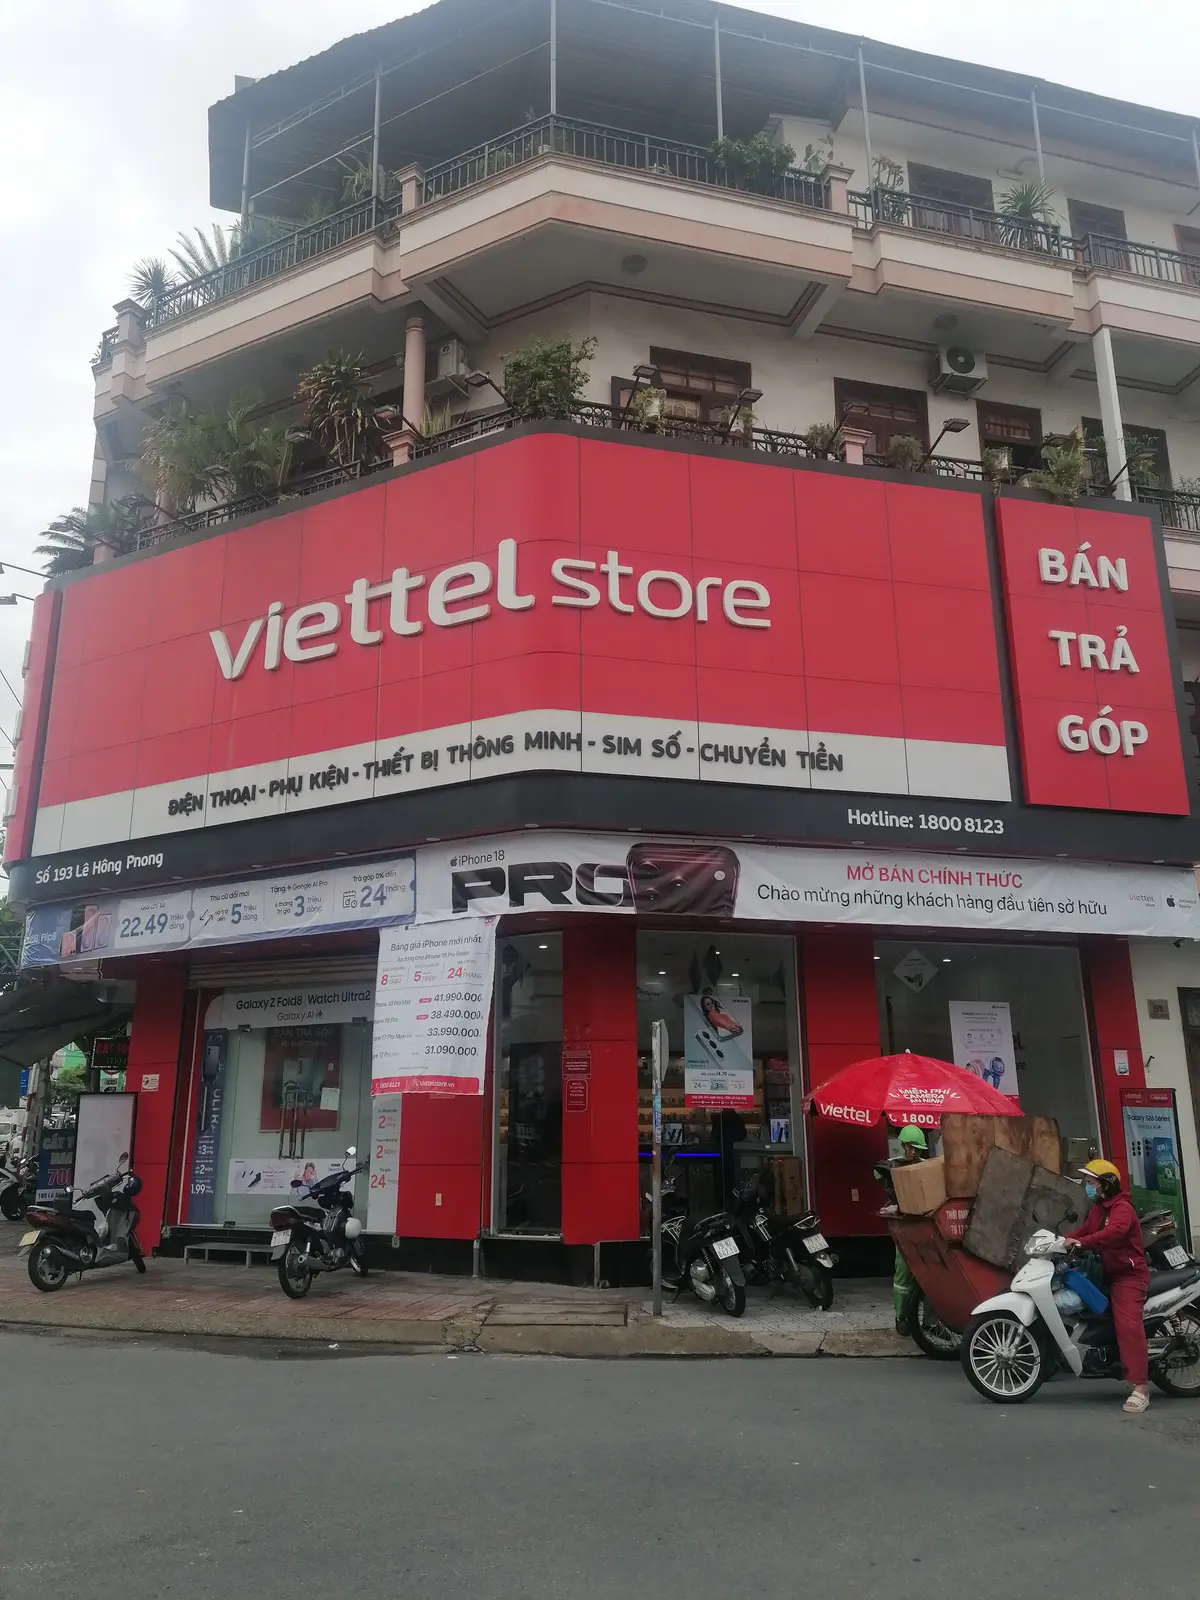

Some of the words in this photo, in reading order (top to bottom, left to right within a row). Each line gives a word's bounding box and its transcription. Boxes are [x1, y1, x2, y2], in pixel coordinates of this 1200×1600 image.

[1038, 541, 1129, 592] BÁN
[209, 538, 535, 681] viettel
[551, 550, 772, 629] store
[1048, 625, 1140, 674] TRẢ
[1057, 705, 1149, 757] GÓP
[168, 791, 203, 817] ĐIỆN
[209, 784, 257, 808] THOẠI
[269, 776, 302, 798] PHỤ
[309, 764, 350, 791] KIỆN
[363, 746, 415, 781] THIẾT
[420, 749, 438, 772] BỊ
[446, 735, 514, 766] THÔNG
[524, 730, 582, 752] MINH
[602, 734, 642, 757] SIM
[651, 730, 682, 759] SỐ
[700, 736, 786, 768] CHUYỂN
[796, 741, 844, 772] TIỀN
[848, 808, 914, 830] Hotline:
[918, 813, 962, 832] 1800
[964, 817, 1004, 835] 8123
[458, 852, 493, 867] iPhone
[494, 849, 505, 862] 18
[35, 865, 52, 884] Số
[53, 866, 73, 882] 193
[75, 862, 90, 878] Lê
[846, 863, 875, 882] MỞ
[878, 863, 915, 884] BÁN
[918, 864, 972, 886] CHÍNH
[975, 868, 1023, 889] THỨC
[294, 895, 305, 917] 3
[360, 883, 387, 908] 24
[756, 883, 800, 903] Chào
[803, 887, 850, 907] mừng
[853, 888, 903, 909] những
[907, 891, 954, 909] khách
[957, 894, 993, 914] hàng
[996, 890, 1025, 912] đầu
[1027, 897, 1055, 914] tiên
[1057, 898, 1076, 915] sở
[1078, 899, 1107, 916] hữu
[120, 912, 168, 938] 22.49
[231, 903, 242, 925] 5
[422, 938, 448, 949] iPhone
[380, 974, 389, 985] 8
[414, 971, 422, 982] 5
[447, 967, 463, 980] 24
[236, 999, 269, 1011] Galaxy
[270, 998, 276, 1008] Z
[277, 995, 303, 1007] Fold8
[307, 992, 340, 1005] Watch
[342, 990, 371, 1002] Ultra2
[277, 1011, 306, 1022] Galaxy
[307, 1010, 315, 1019] AI
[379, 1115, 386, 1129] 2
[376, 1145, 384, 1159] 2
[191, 1184, 206, 1194] 1.99
[370, 1174, 386, 1189] 24
